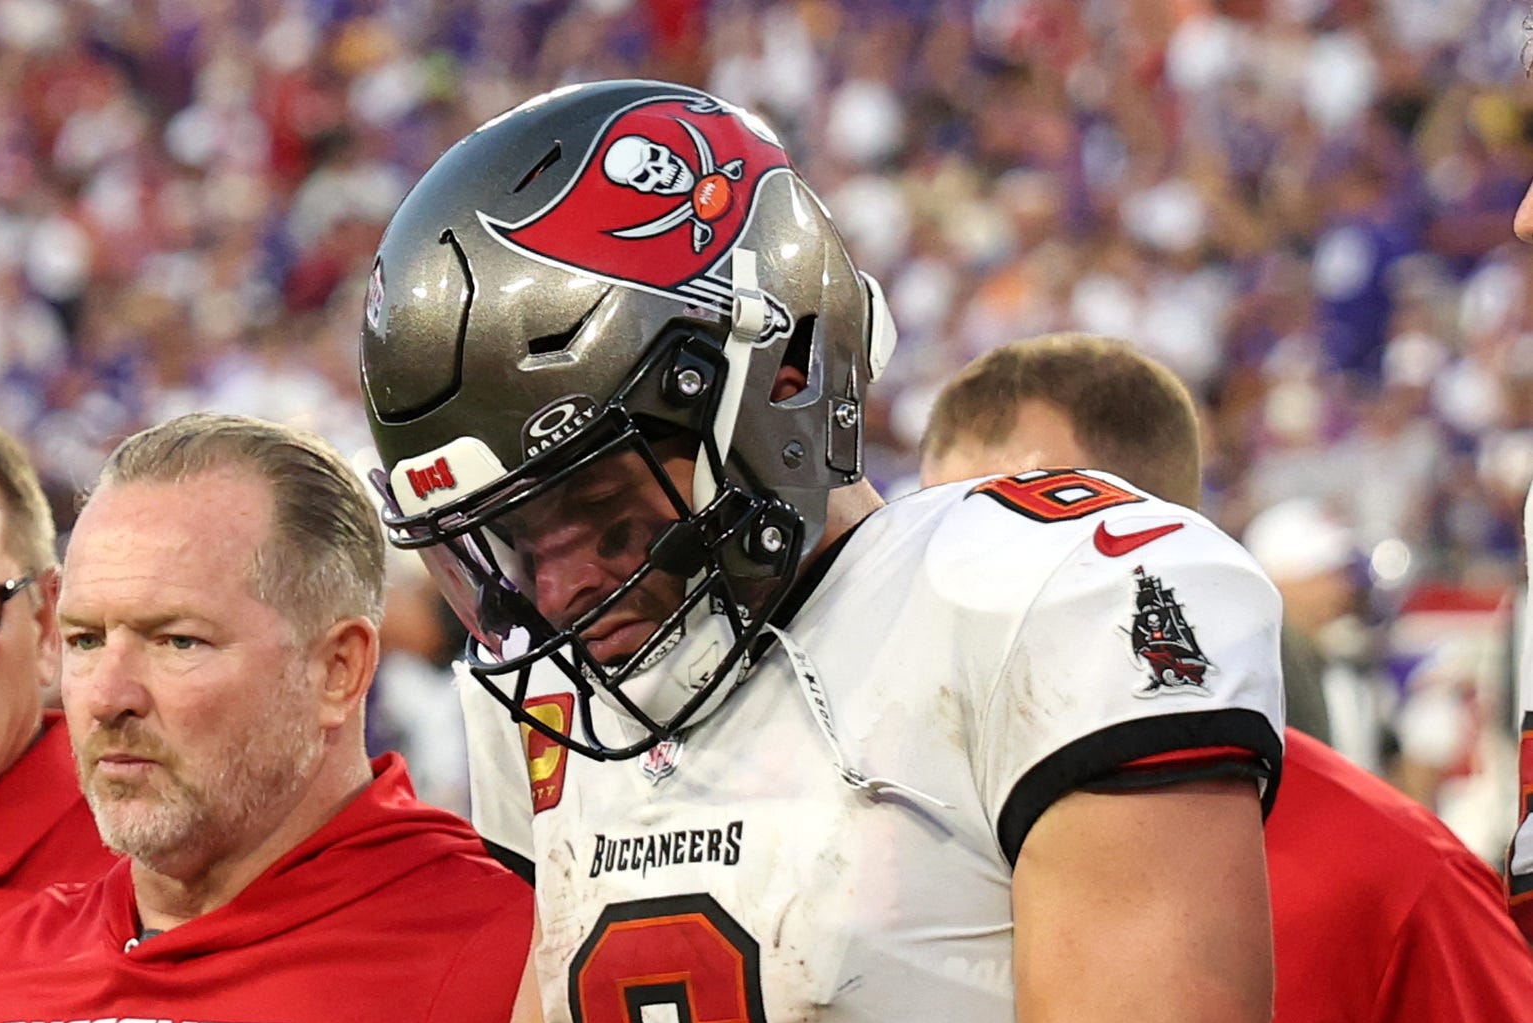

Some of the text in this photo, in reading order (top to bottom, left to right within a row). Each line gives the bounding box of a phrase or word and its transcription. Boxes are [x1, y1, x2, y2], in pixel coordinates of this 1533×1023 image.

[528, 406, 595, 458] OAKLEY
[964, 467, 1148, 524] 6
[589, 820, 743, 880] BUCCANEERS
